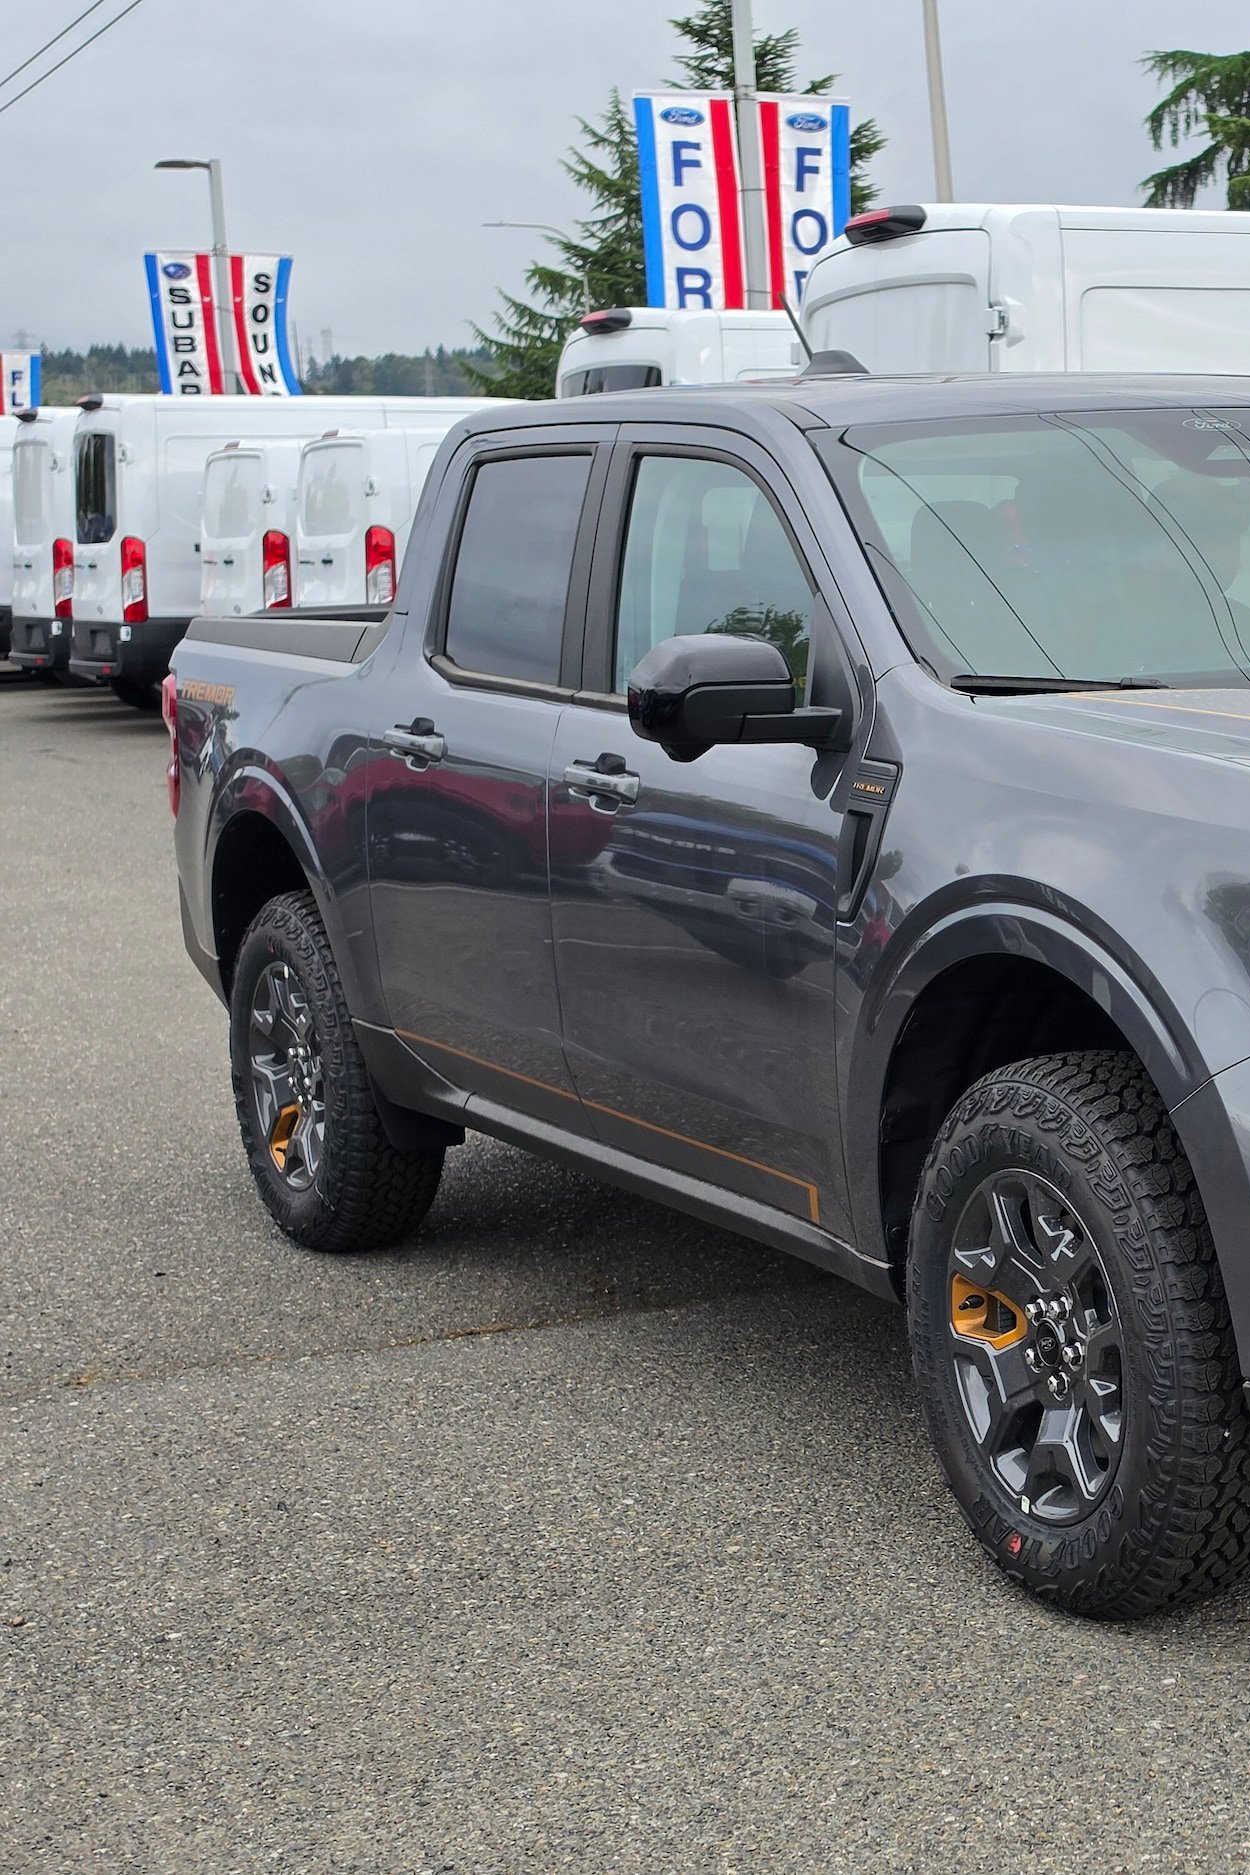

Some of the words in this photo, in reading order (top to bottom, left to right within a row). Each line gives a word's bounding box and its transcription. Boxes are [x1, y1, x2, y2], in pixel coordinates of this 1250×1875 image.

[791, 146, 828, 304] FO
[252, 273, 282, 395] SOUN
[181, 680, 237, 706] TREMOR
